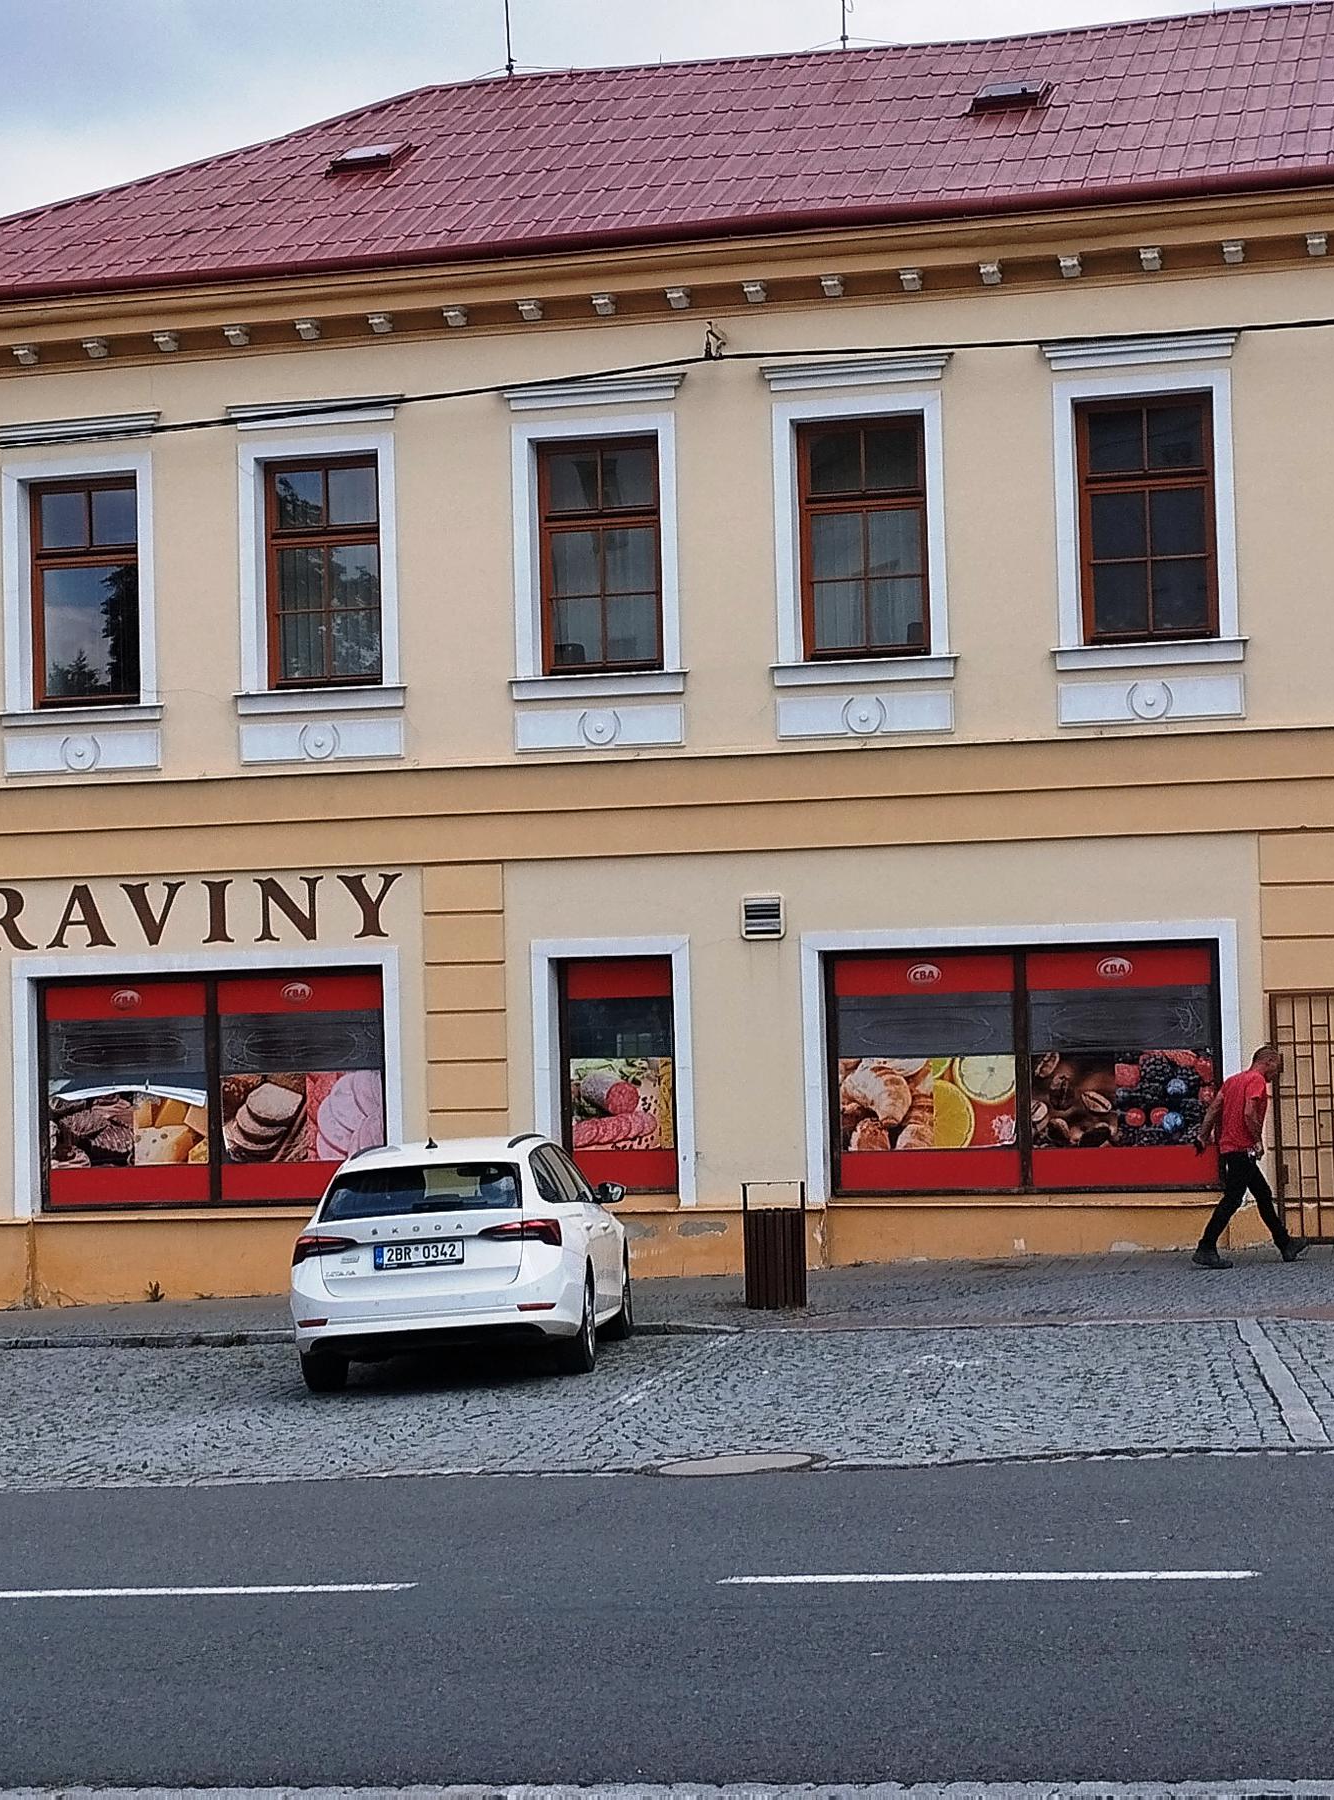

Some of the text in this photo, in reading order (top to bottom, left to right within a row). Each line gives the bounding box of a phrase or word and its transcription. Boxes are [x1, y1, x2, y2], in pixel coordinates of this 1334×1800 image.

[1102, 963, 1127, 975] CBA
[912, 970, 936, 981] CBA
[387, 1246, 412, 1262] 2BR
[422, 1243, 457, 1259] 0342
